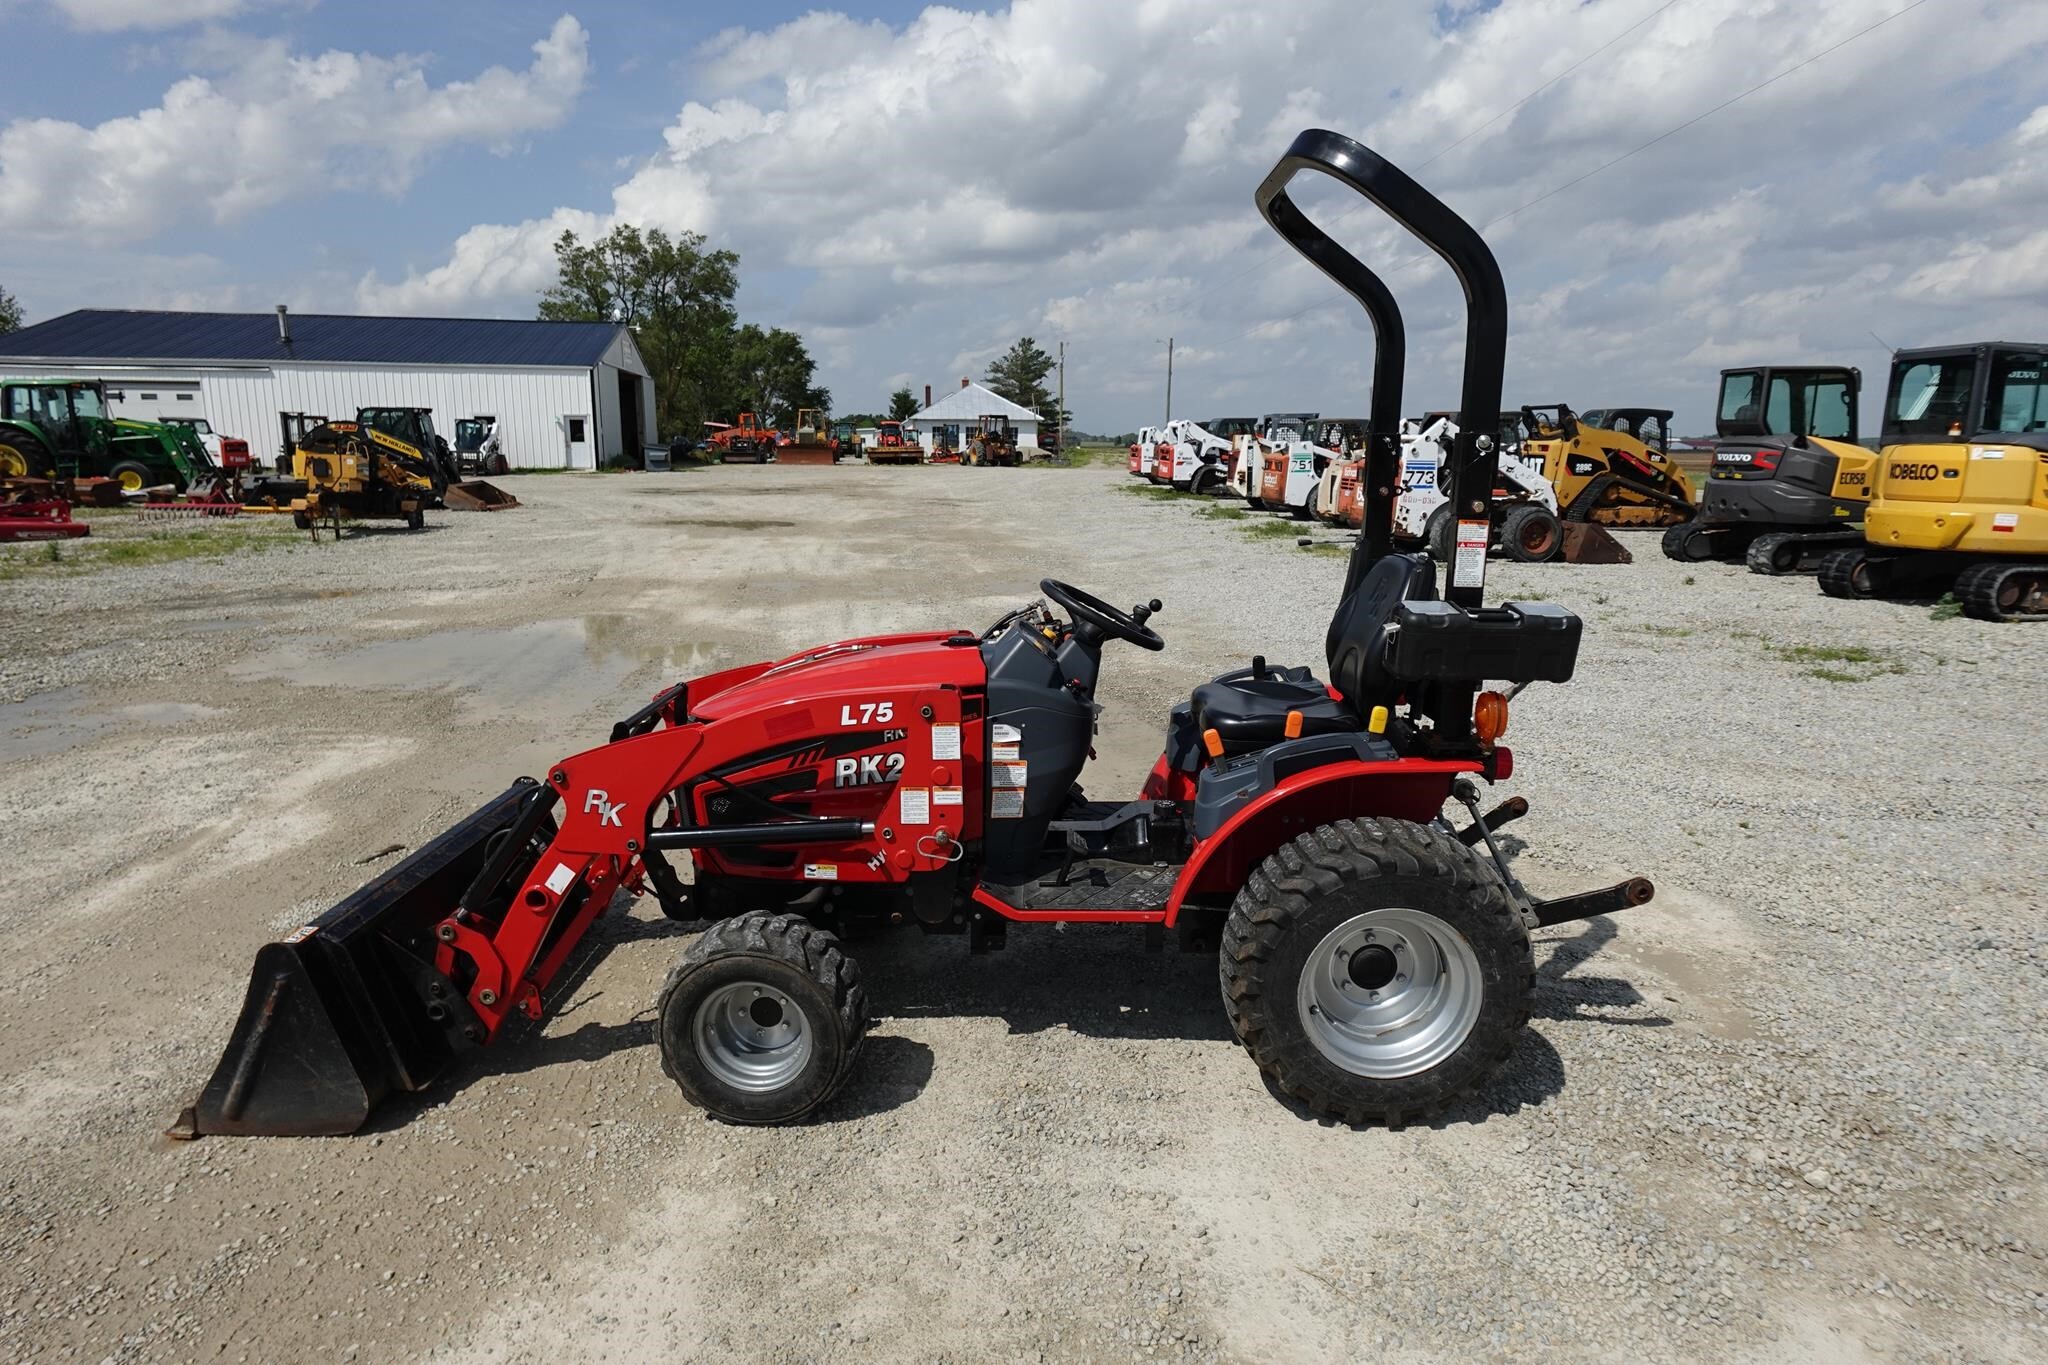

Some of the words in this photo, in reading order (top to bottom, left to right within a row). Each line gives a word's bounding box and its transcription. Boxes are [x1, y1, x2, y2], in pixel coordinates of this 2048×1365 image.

[1291, 460, 1313, 470] 751
[1717, 453, 1752, 462] VOLVO
[1405, 470, 1435, 485] 773
[1889, 463, 1939, 481] KOBELCO
[841, 702, 894, 726] L75
[835, 753, 905, 788] RK2
[583, 789, 627, 827] RK
[867, 848, 888, 872] Hy
